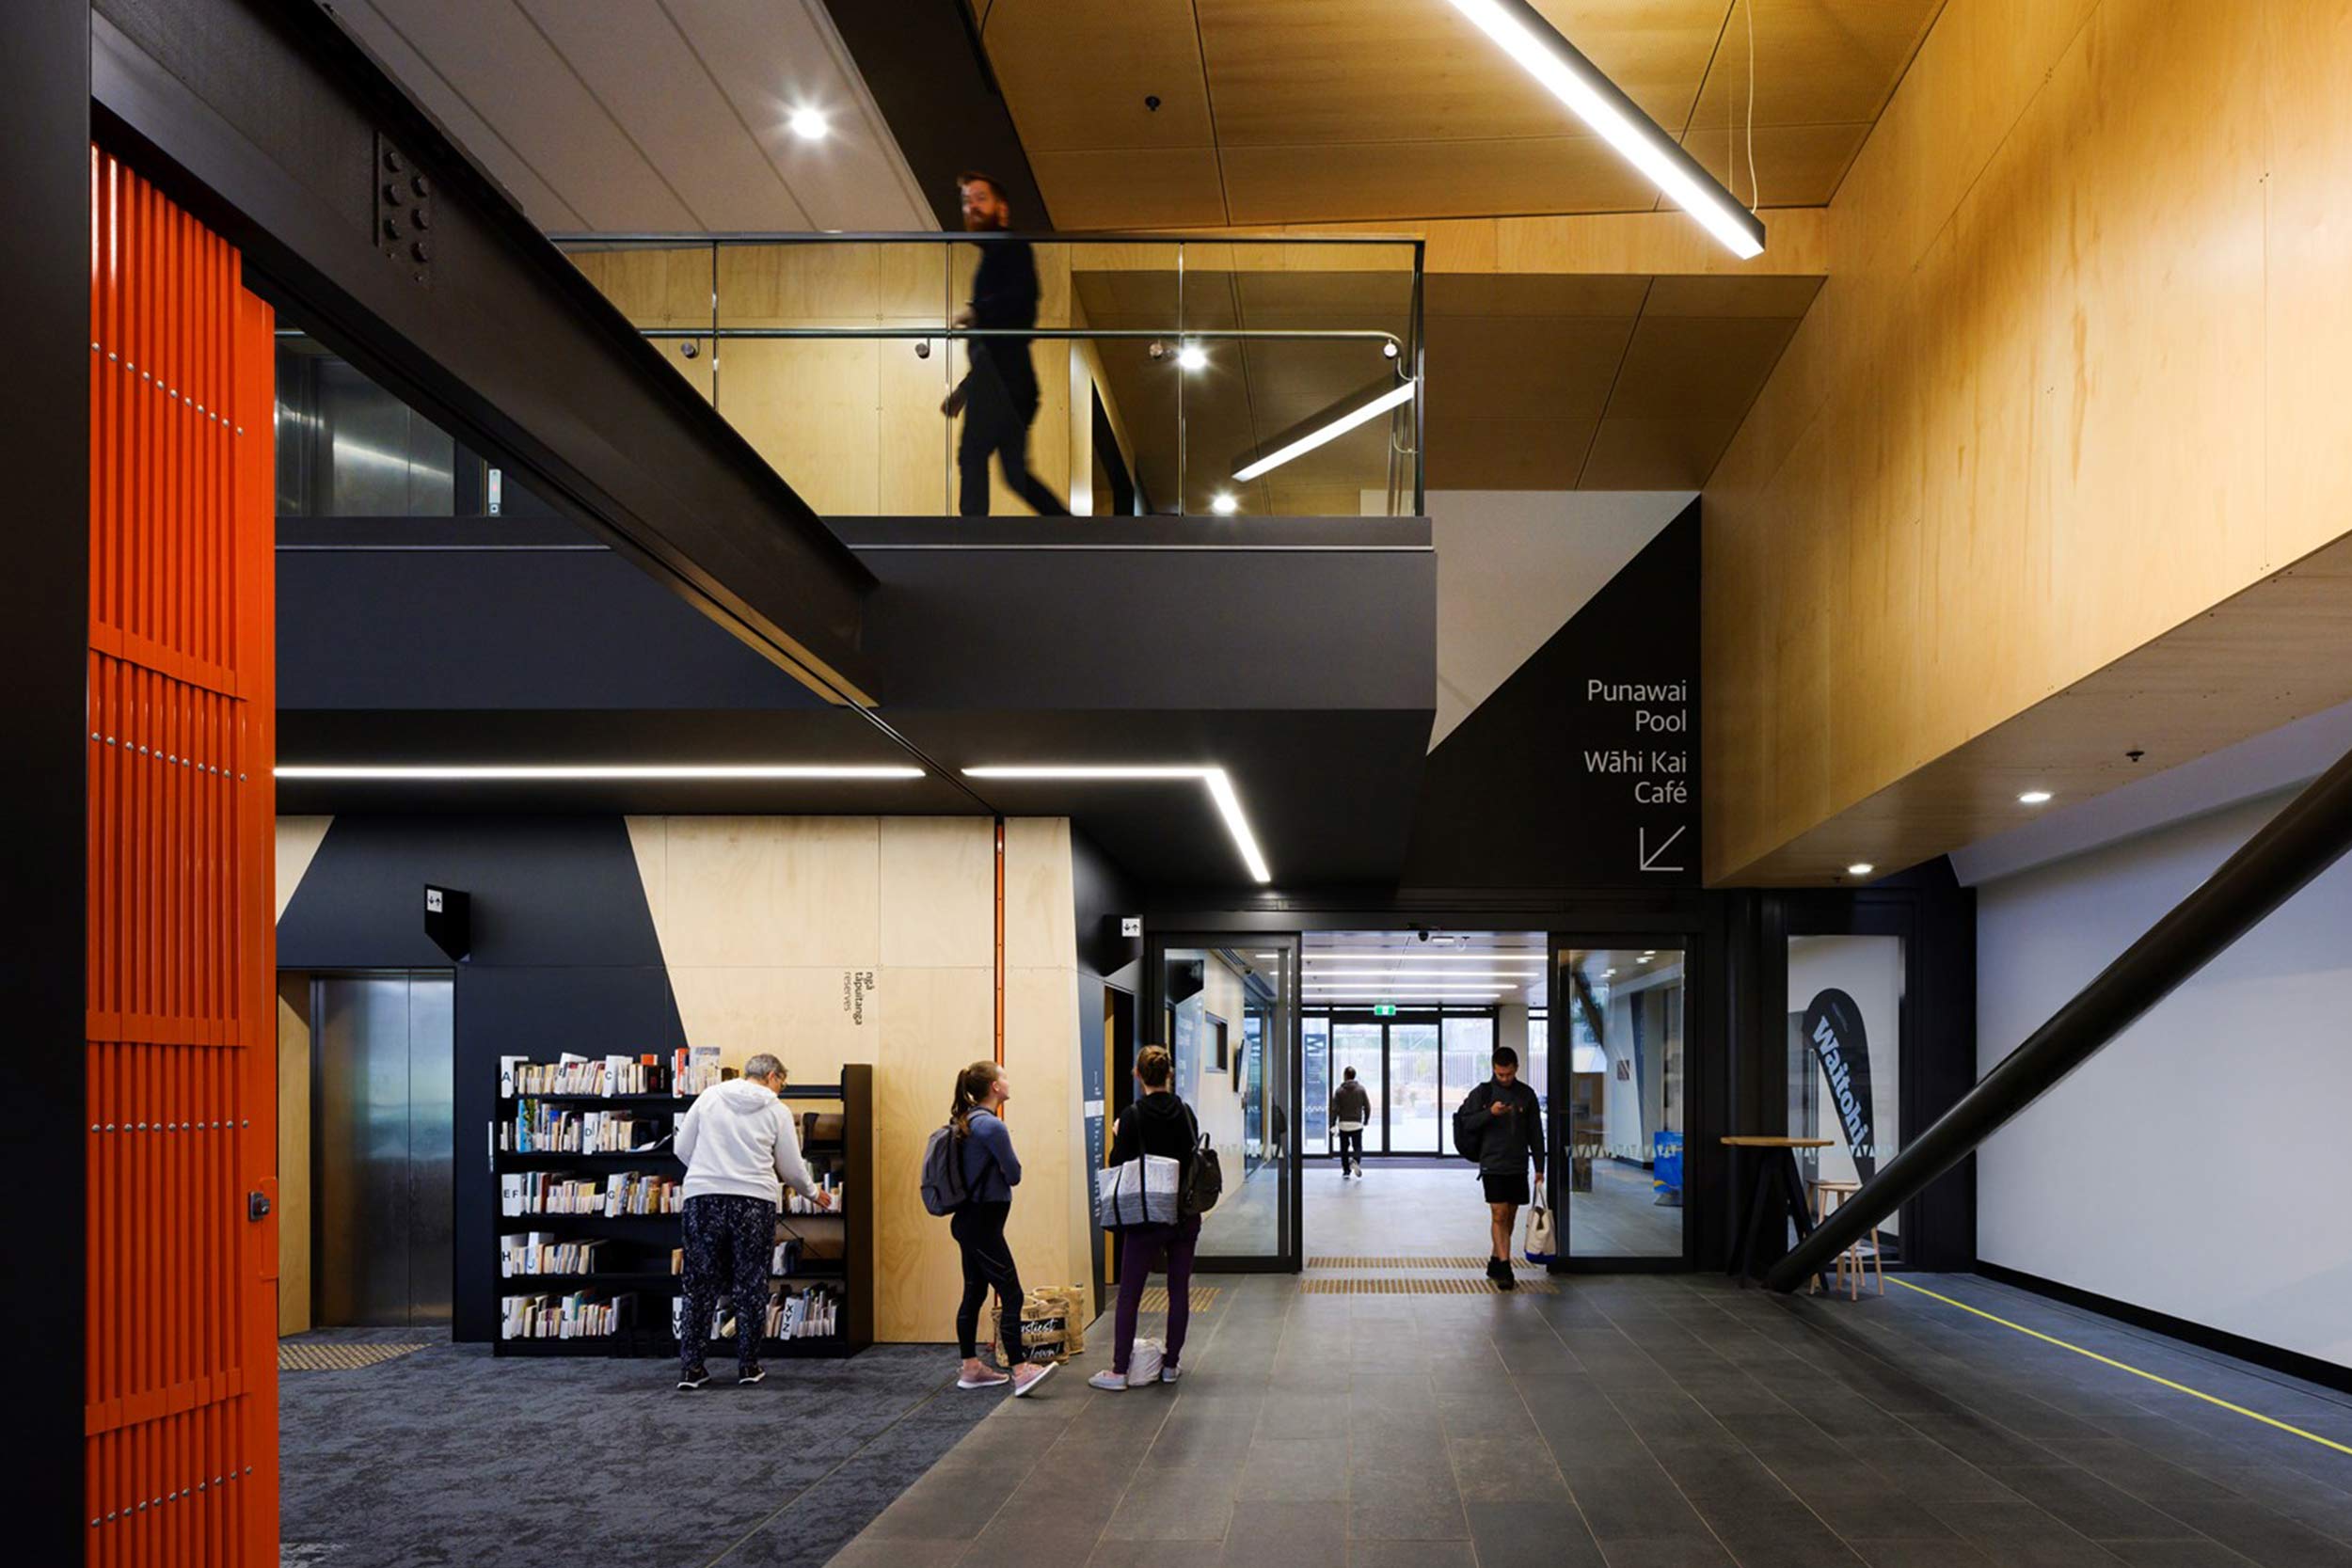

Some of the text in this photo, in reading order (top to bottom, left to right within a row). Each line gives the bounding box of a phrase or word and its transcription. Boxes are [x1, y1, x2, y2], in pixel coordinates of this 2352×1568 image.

[1587, 678, 1687, 702] Punawai
[1635, 708, 1687, 732] Pool
[1583, 750, 1687, 772] Wāhi Kai
[1634, 780, 1688, 803] Café
[843, 972, 851, 1012] reserves
[501, 1071, 512, 1082] A
[605, 1071, 612, 1080] C
[1812, 1015, 1869, 1150] Waitohi
[584, 1128, 593, 1137] D
[607, 1190, 615, 1199] G
[501, 1250, 512, 1261] H
